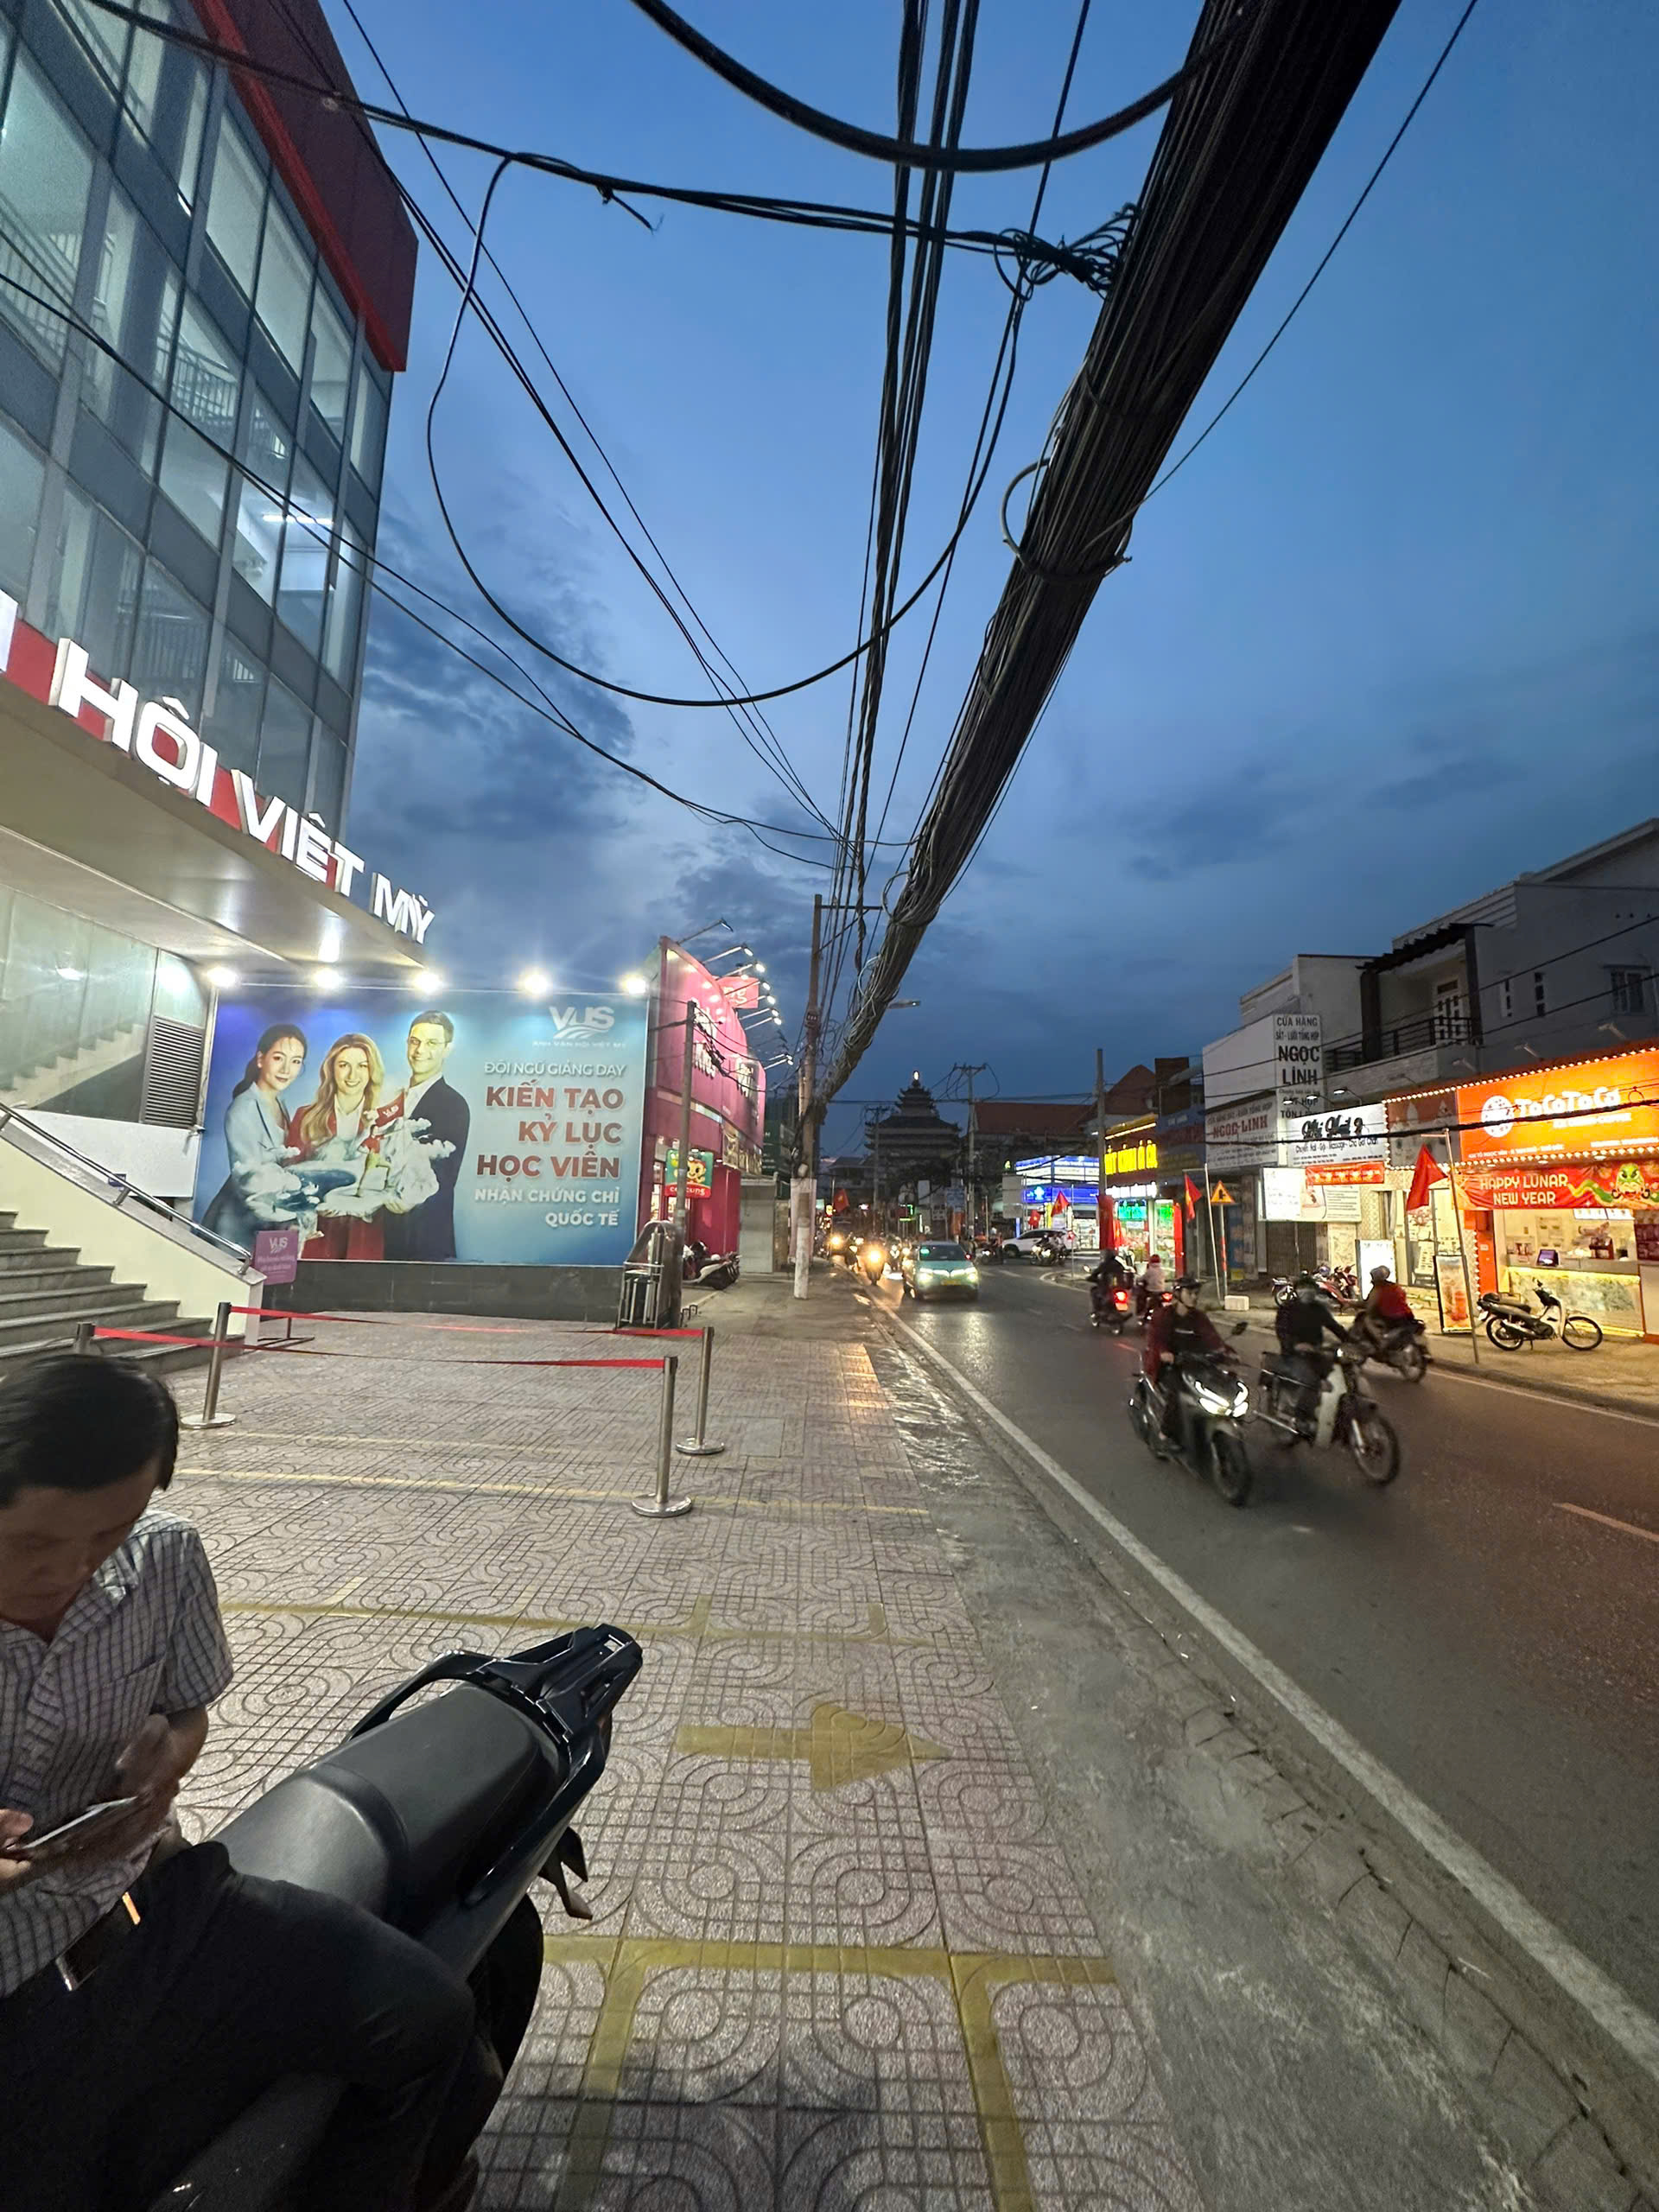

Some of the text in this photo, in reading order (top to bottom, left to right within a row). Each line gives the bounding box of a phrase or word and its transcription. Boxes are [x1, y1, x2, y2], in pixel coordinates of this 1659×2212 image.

[50, 638, 219, 808] HỘI
[549, 1007, 615, 1031] VUS
[1278, 1045, 1320, 1065] NGỌC
[486, 1079, 624, 1115] KIẾN TẠO
[518, 1113, 623, 1149] KỶ LỤC
[477, 1151, 620, 1182] HỌC VIÊN
[1480, 1173, 1568, 1190] HAPPY LUNAR
[528, 1187, 587, 1203] CHỨNG
[591, 1186, 620, 1204] CHỈ
[1493, 1192, 1556, 1205] NEW YEAR
[545, 1209, 620, 1227] QUỐC TẾ
